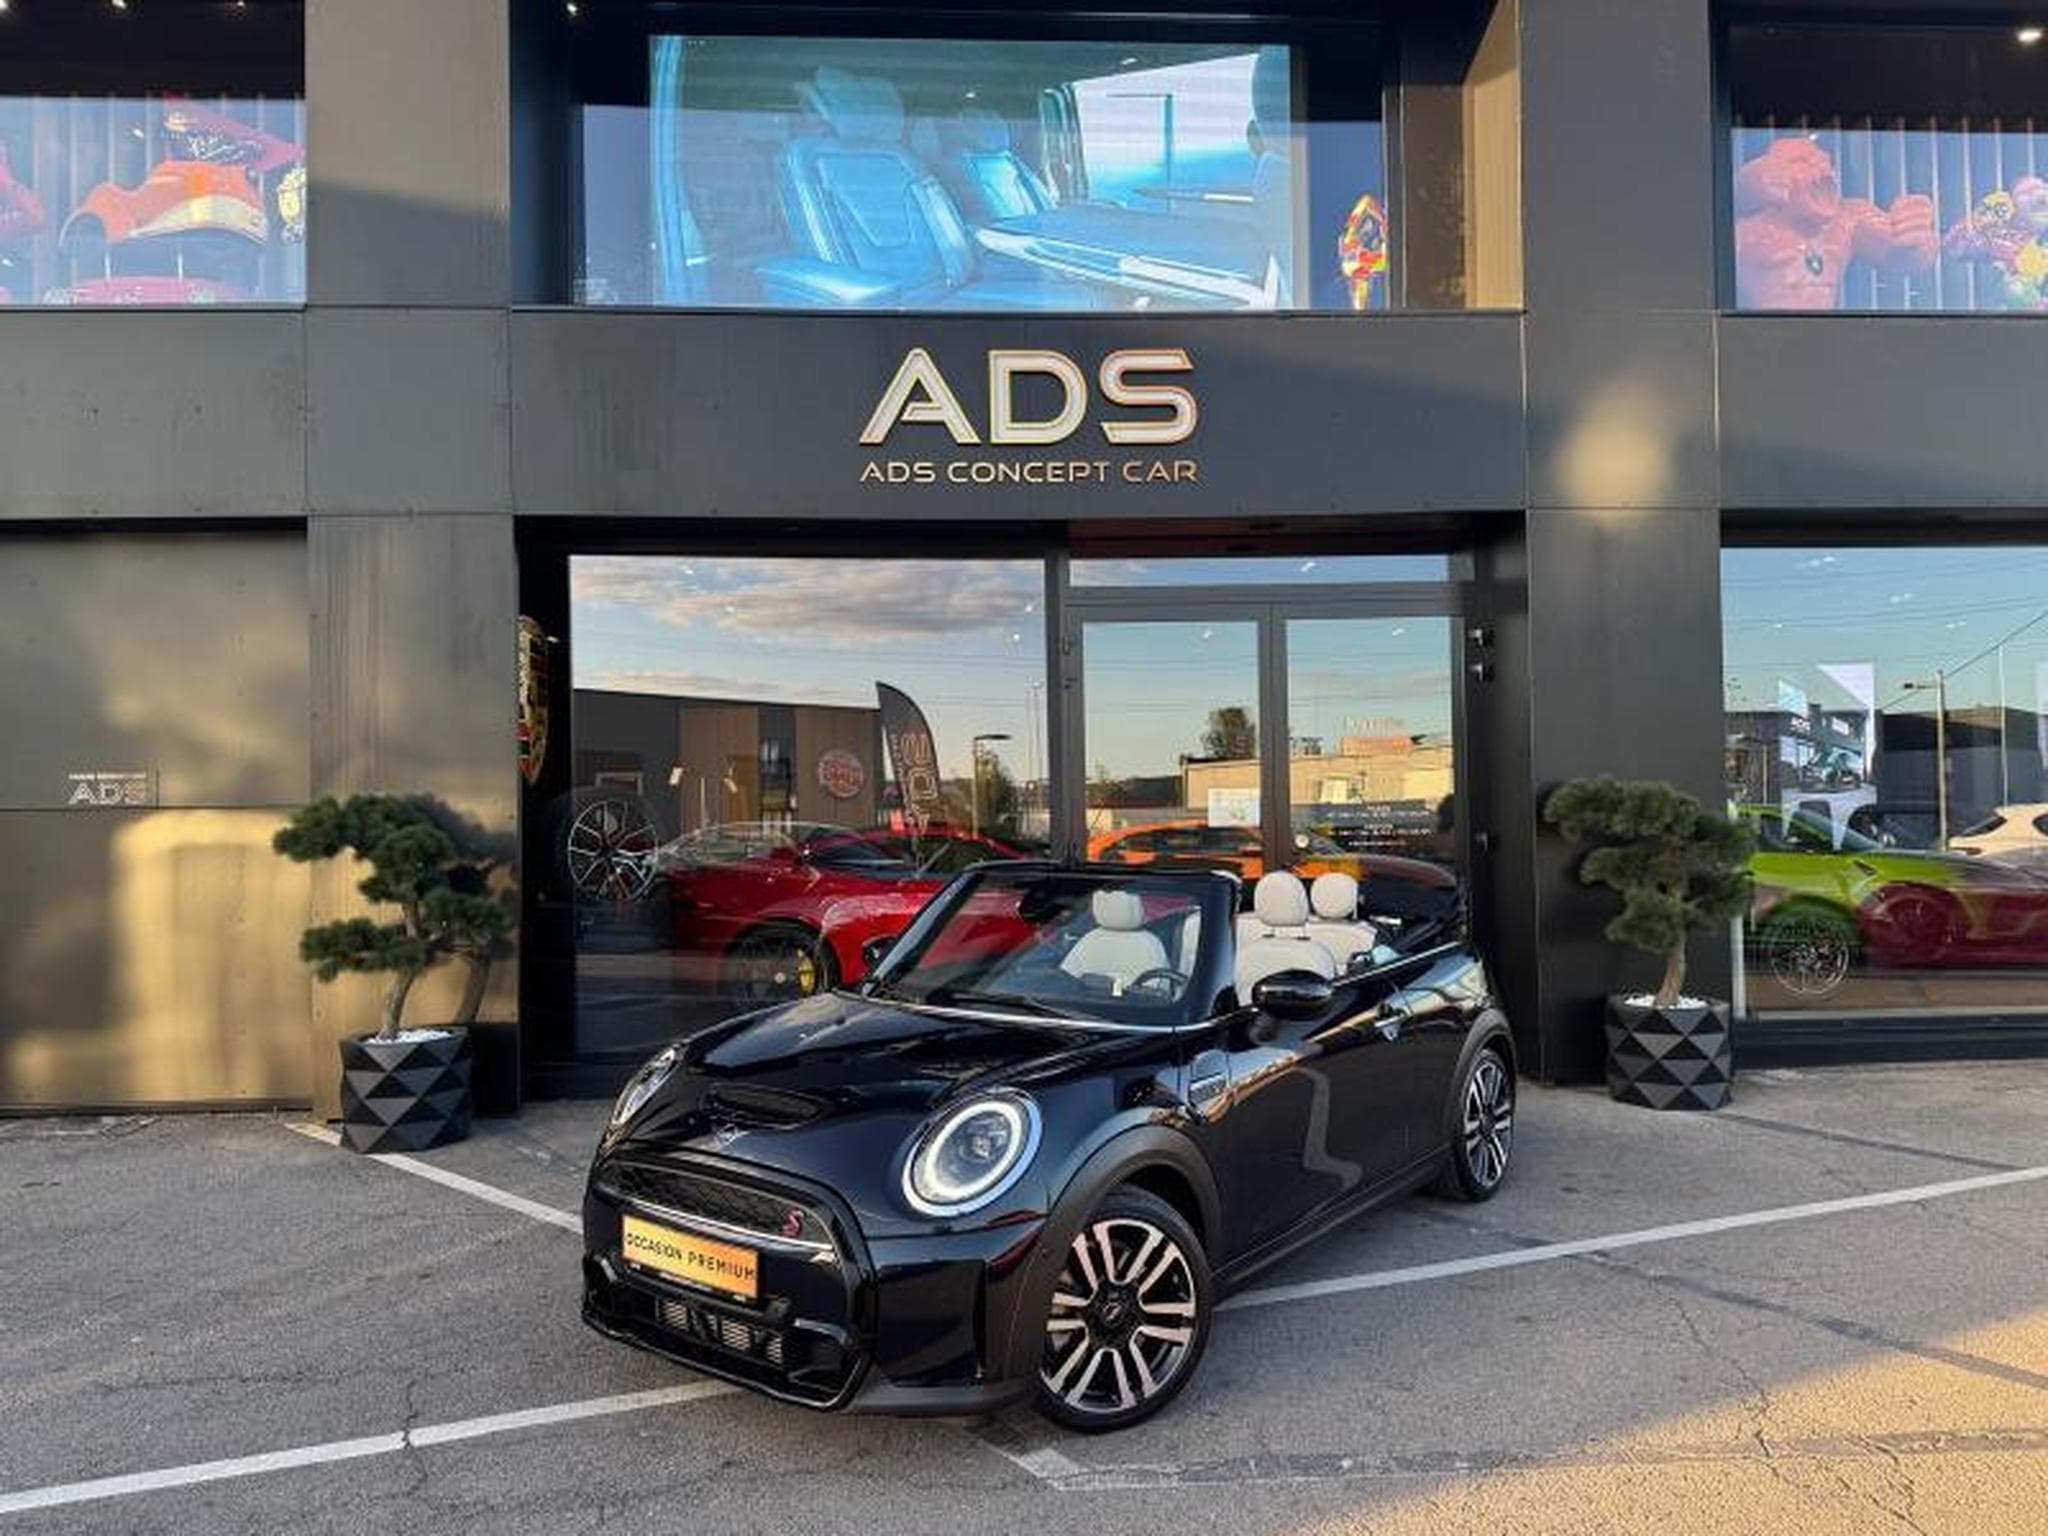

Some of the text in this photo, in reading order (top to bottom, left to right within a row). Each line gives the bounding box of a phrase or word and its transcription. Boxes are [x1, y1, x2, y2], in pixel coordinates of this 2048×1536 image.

[859, 347, 1197, 445] ADS
[859, 459, 1197, 483] ADS CONCEPT CAR
[626, 1232, 755, 1280] OCCASION PREMIUM
